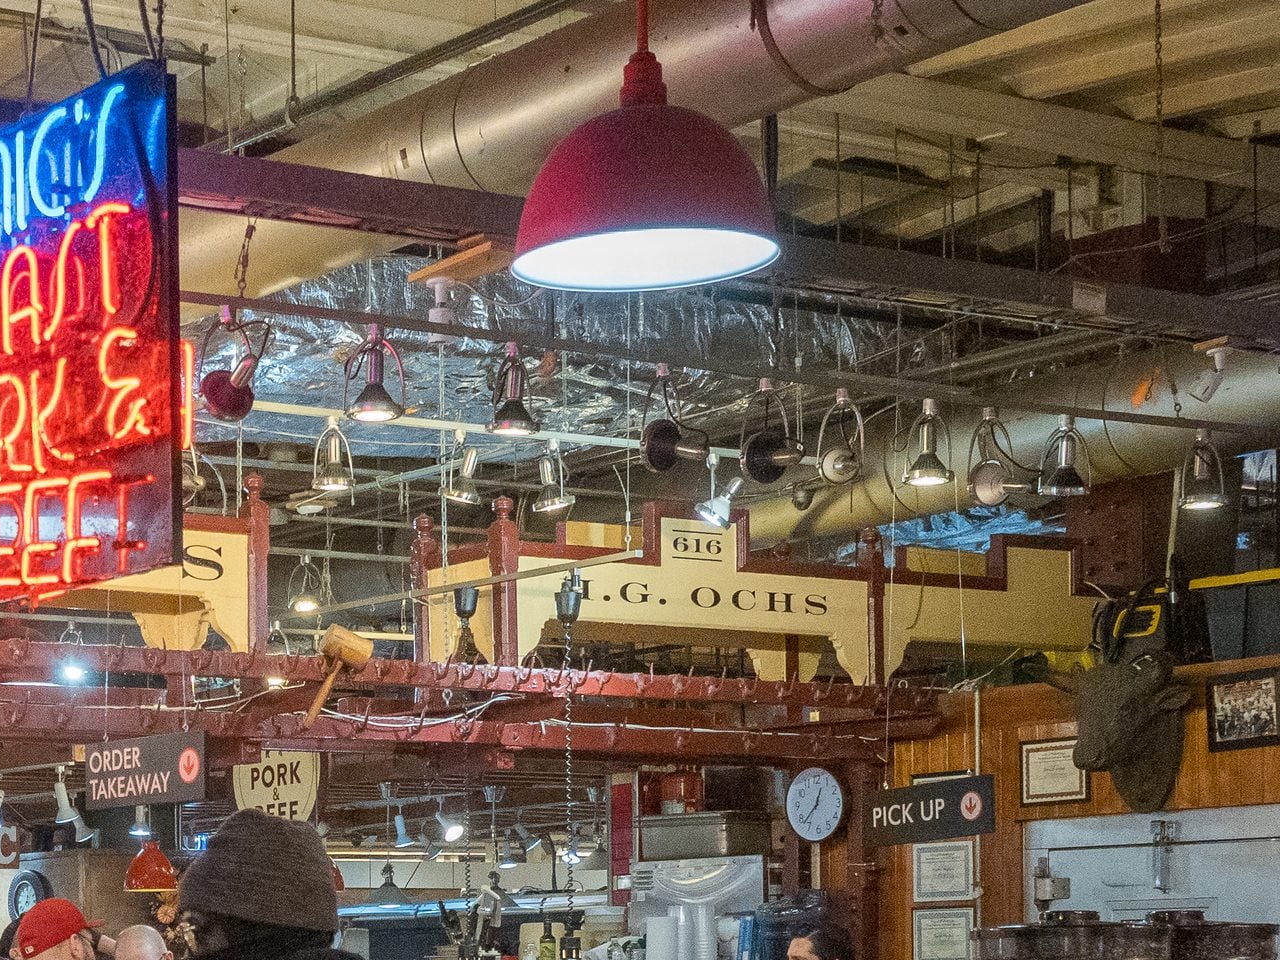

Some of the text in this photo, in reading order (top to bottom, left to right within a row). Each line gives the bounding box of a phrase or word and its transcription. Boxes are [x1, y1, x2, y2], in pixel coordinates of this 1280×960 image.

[673, 536, 722, 555] 616
[691, 586, 828, 616] OCHS
[89, 746, 140, 774] ORDER
[89, 771, 170, 801] TAKEAWAY
[251, 761, 301, 790] PORK
[273, 787, 279, 800] &
[872, 798, 945, 828] PICK UP
